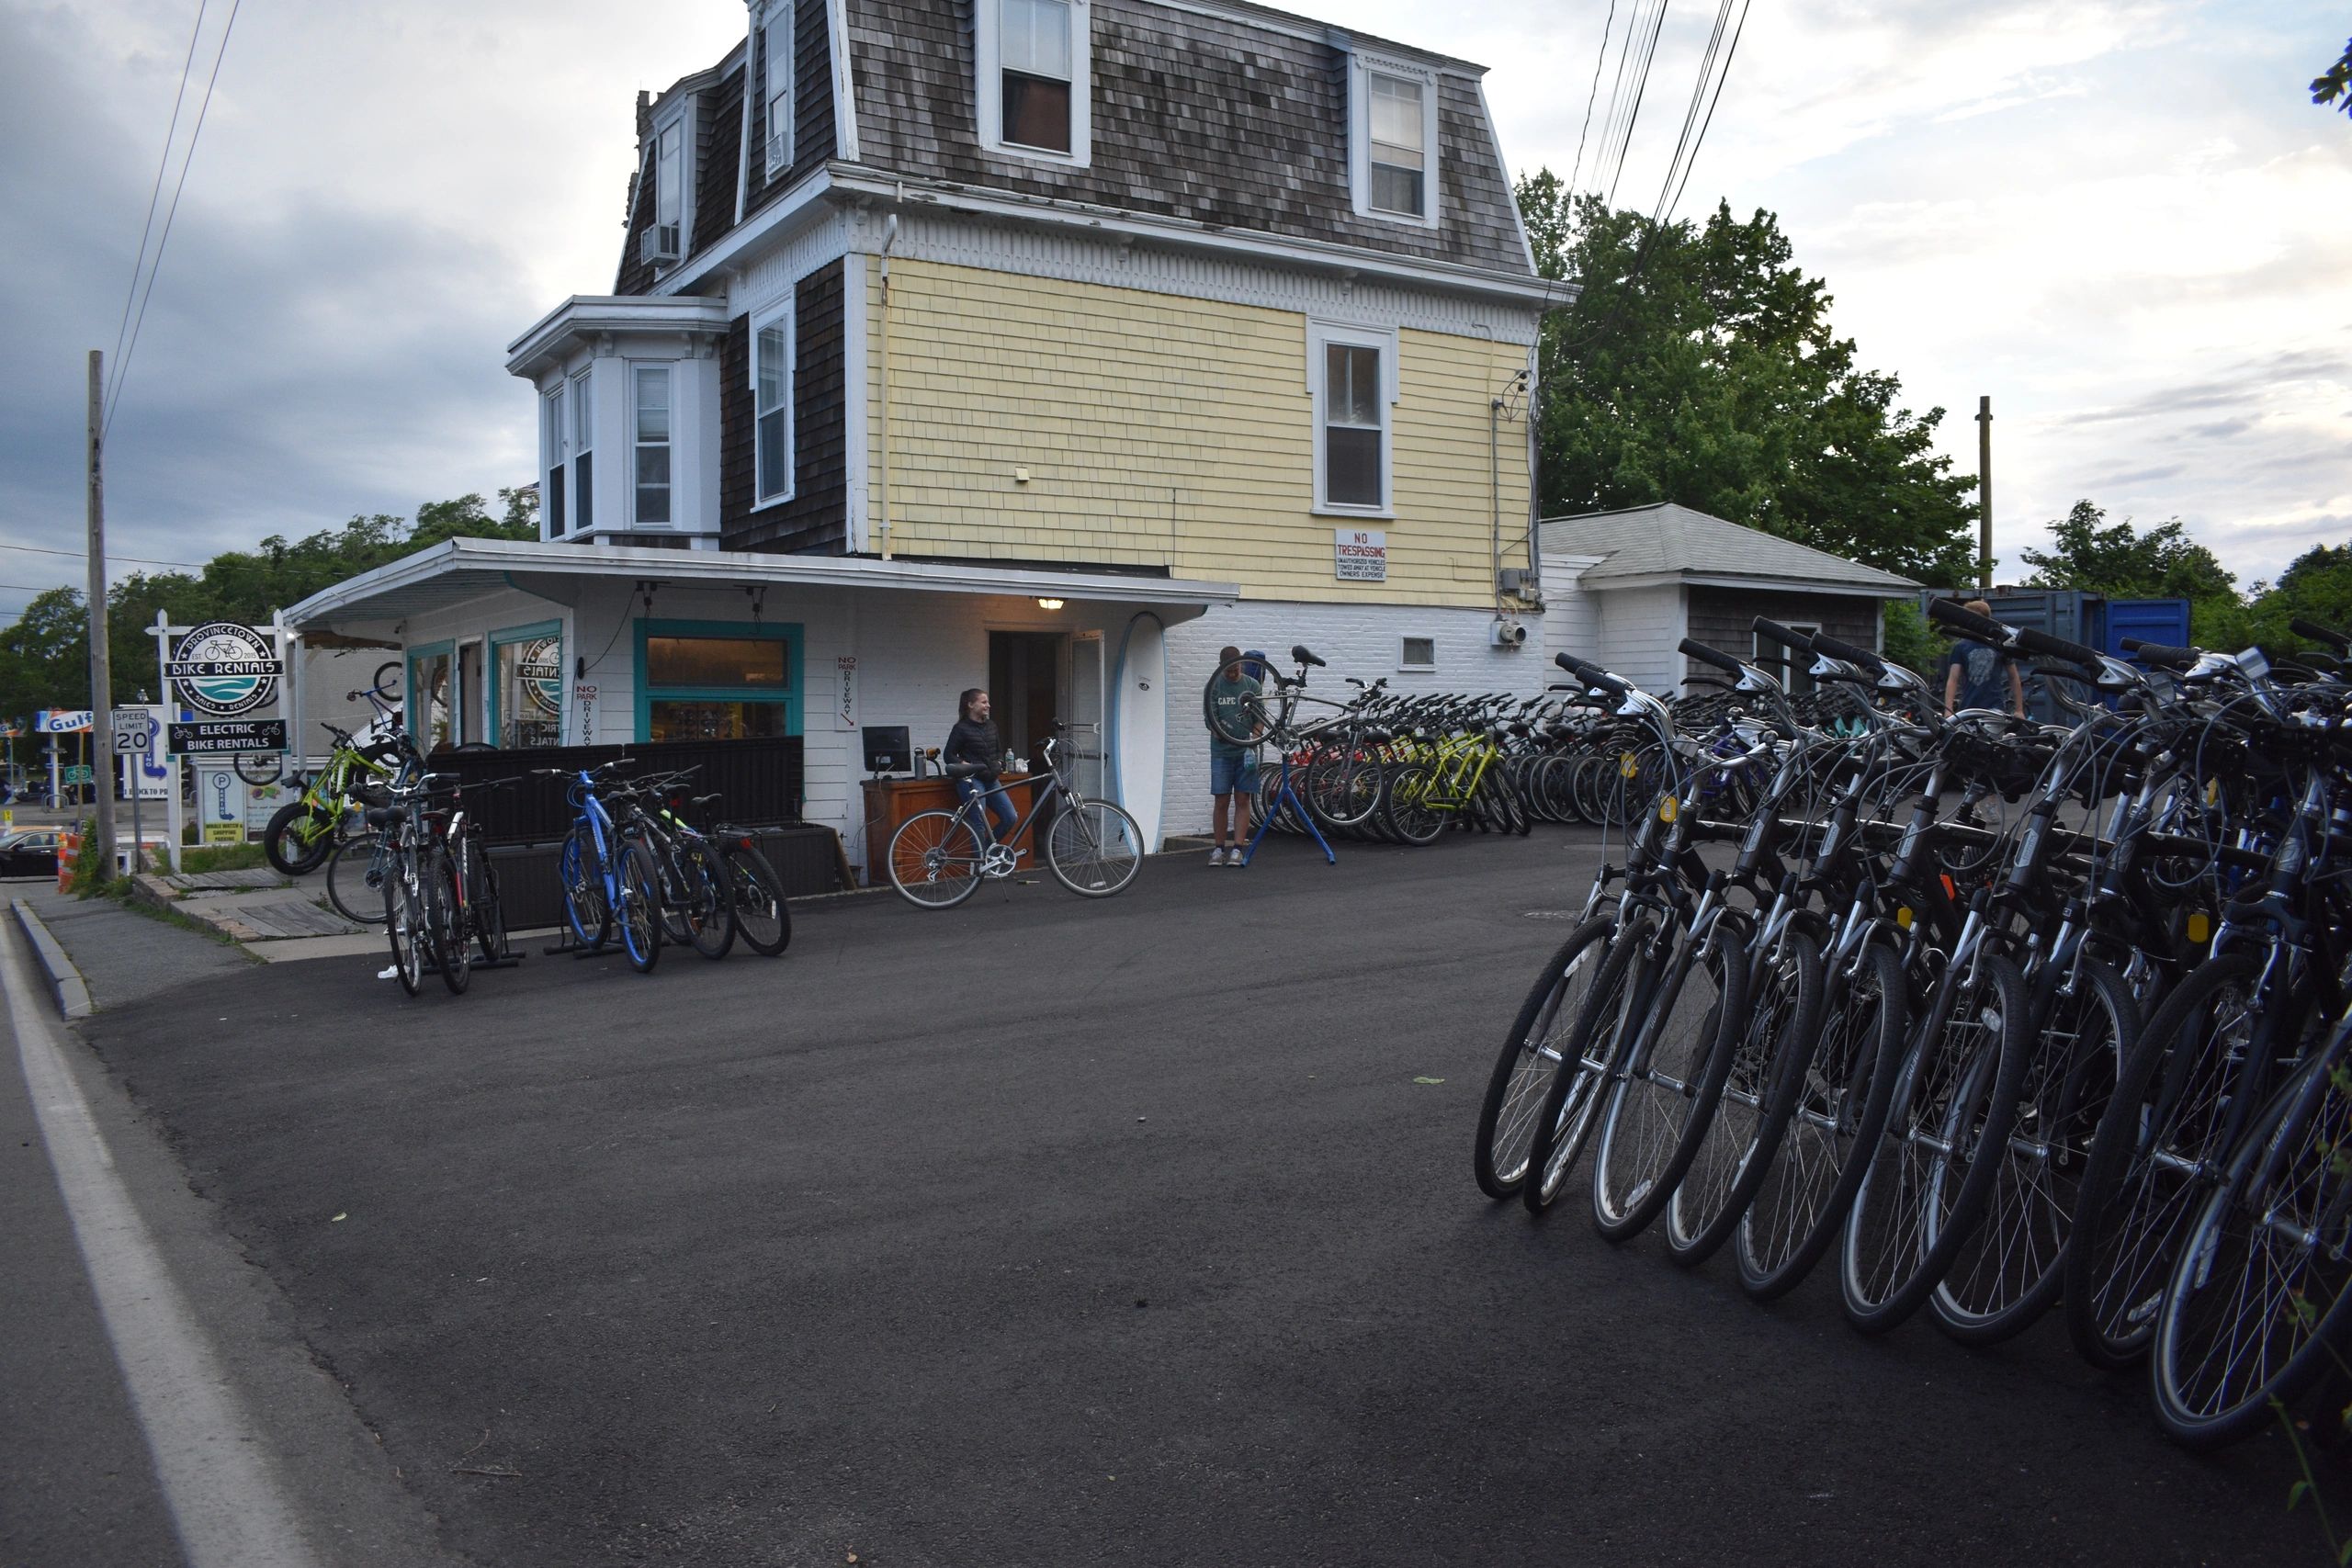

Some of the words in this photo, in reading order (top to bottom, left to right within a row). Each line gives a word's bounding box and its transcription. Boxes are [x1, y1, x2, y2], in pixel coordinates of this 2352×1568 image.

[1354, 533, 1368, 544] NO
[1338, 545, 1385, 558] TRESPASSING
[187, 626, 261, 649] PROVINCETOWN
[173, 664, 205, 675] BIKE
[215, 661, 275, 673] RENTALS
[843, 671, 853, 715] DRIVEWAY
[195, 694, 216, 710] SALES
[230, 694, 257, 710] RENTALS
[1217, 697, 1236, 705] CAPE
[49, 713, 92, 731] Gulf
[199, 724, 255, 735] ELECTRIC
[582, 701, 593, 746] DRIVEWAY
[117, 732, 147, 749] 20
[187, 739, 214, 750] BIKE
[217, 738, 269, 749] RENTALS
